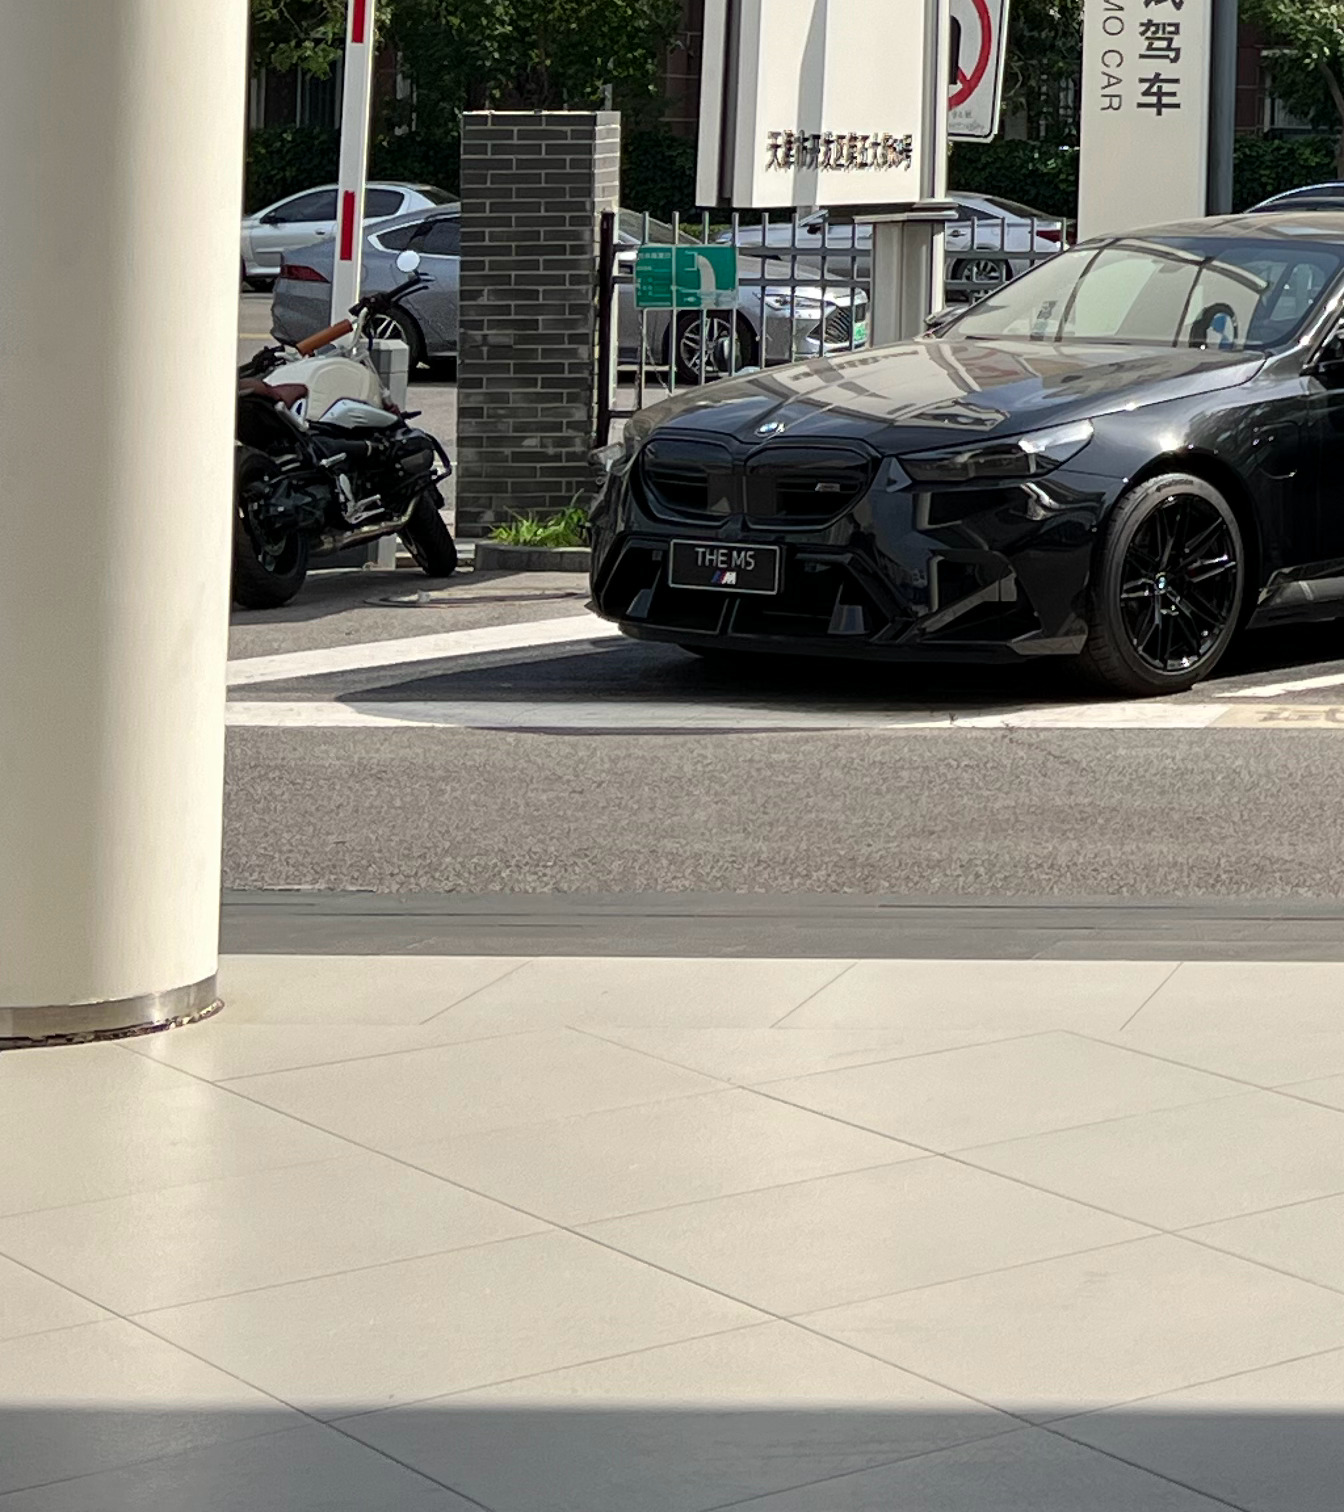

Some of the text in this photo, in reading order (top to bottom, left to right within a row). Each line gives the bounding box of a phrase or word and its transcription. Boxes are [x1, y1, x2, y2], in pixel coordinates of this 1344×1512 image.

[1100, 50, 1124, 112] CAR
[694, 547, 756, 570] THE M5
